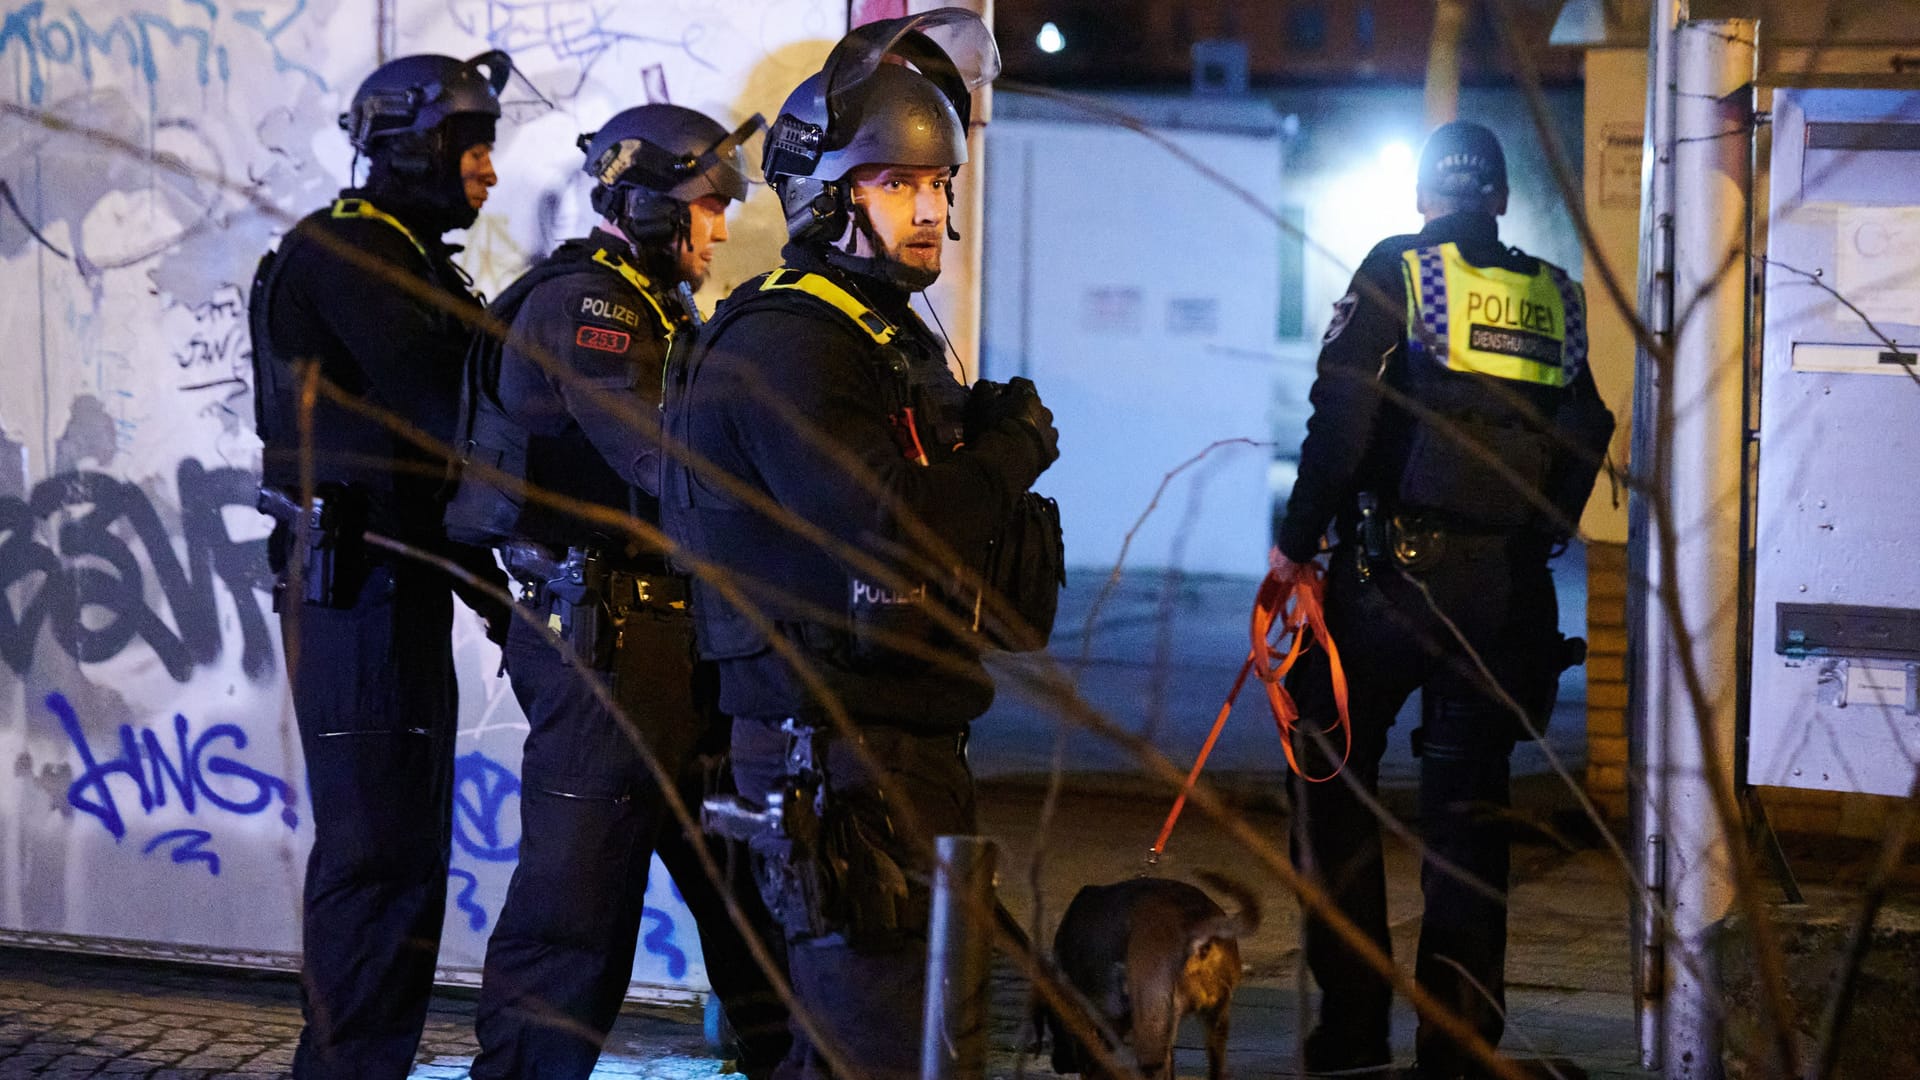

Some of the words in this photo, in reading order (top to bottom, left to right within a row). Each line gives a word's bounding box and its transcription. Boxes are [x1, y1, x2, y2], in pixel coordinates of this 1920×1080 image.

[581, 297, 639, 327] POLIZEI
[1467, 292, 1556, 334] POLIZEI
[1472, 330, 1560, 363] DIENSTHU
